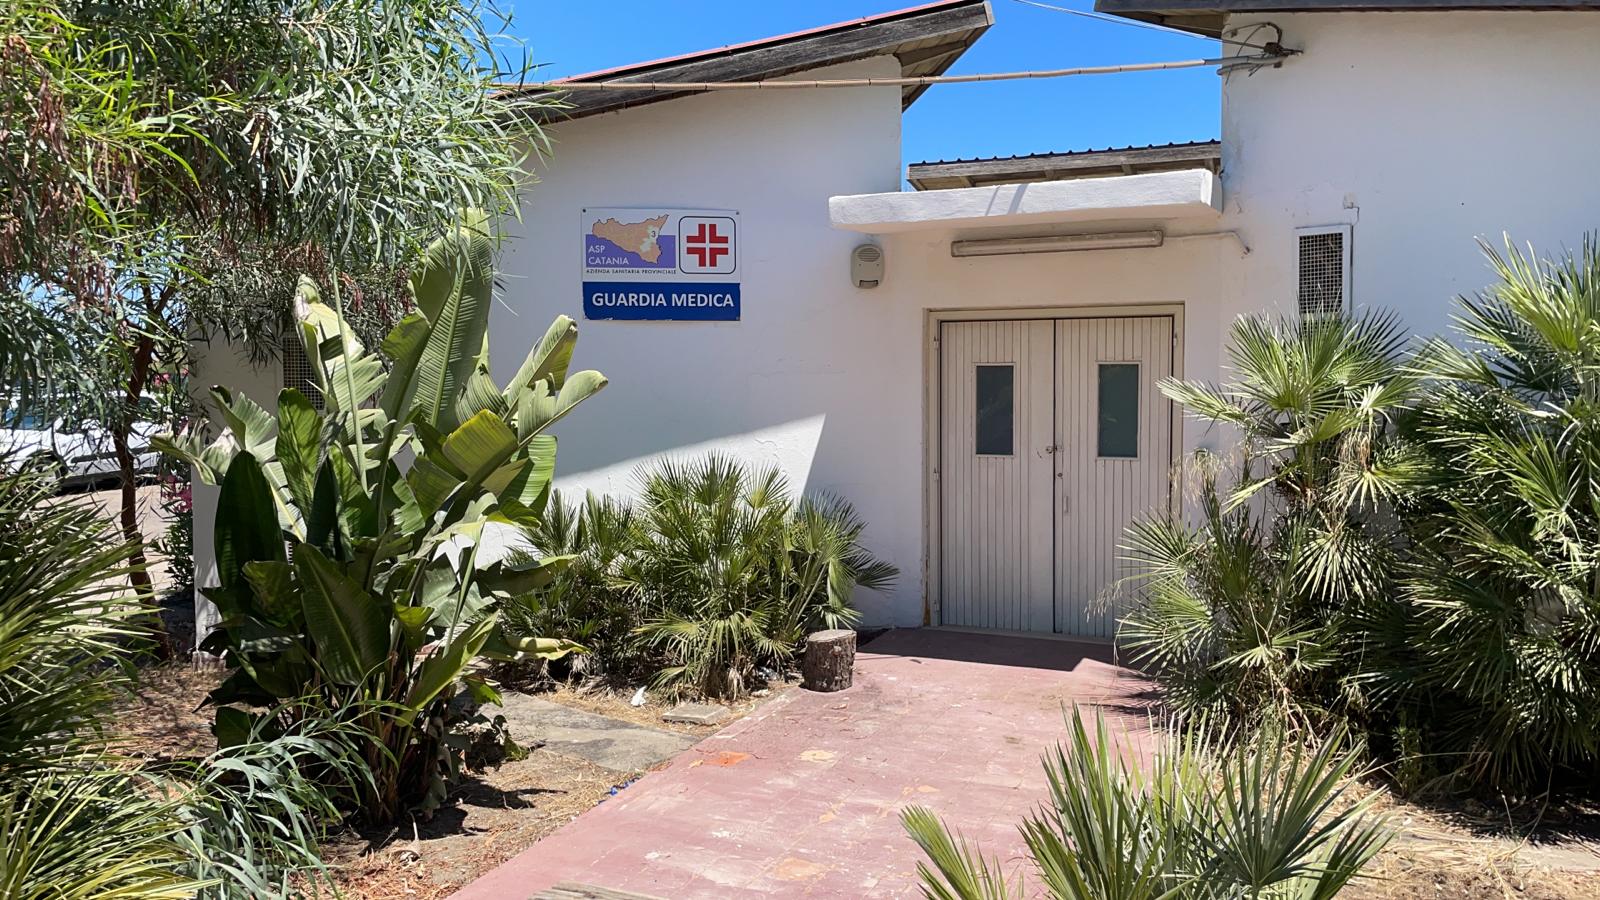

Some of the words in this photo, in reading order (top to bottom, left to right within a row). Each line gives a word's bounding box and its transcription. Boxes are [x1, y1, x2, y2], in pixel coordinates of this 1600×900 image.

[588, 245, 605, 253] ASP
[588, 257, 629, 265] CATANIA
[592, 293, 667, 307] GUARDIA
[671, 293, 735, 307] MEDICA
